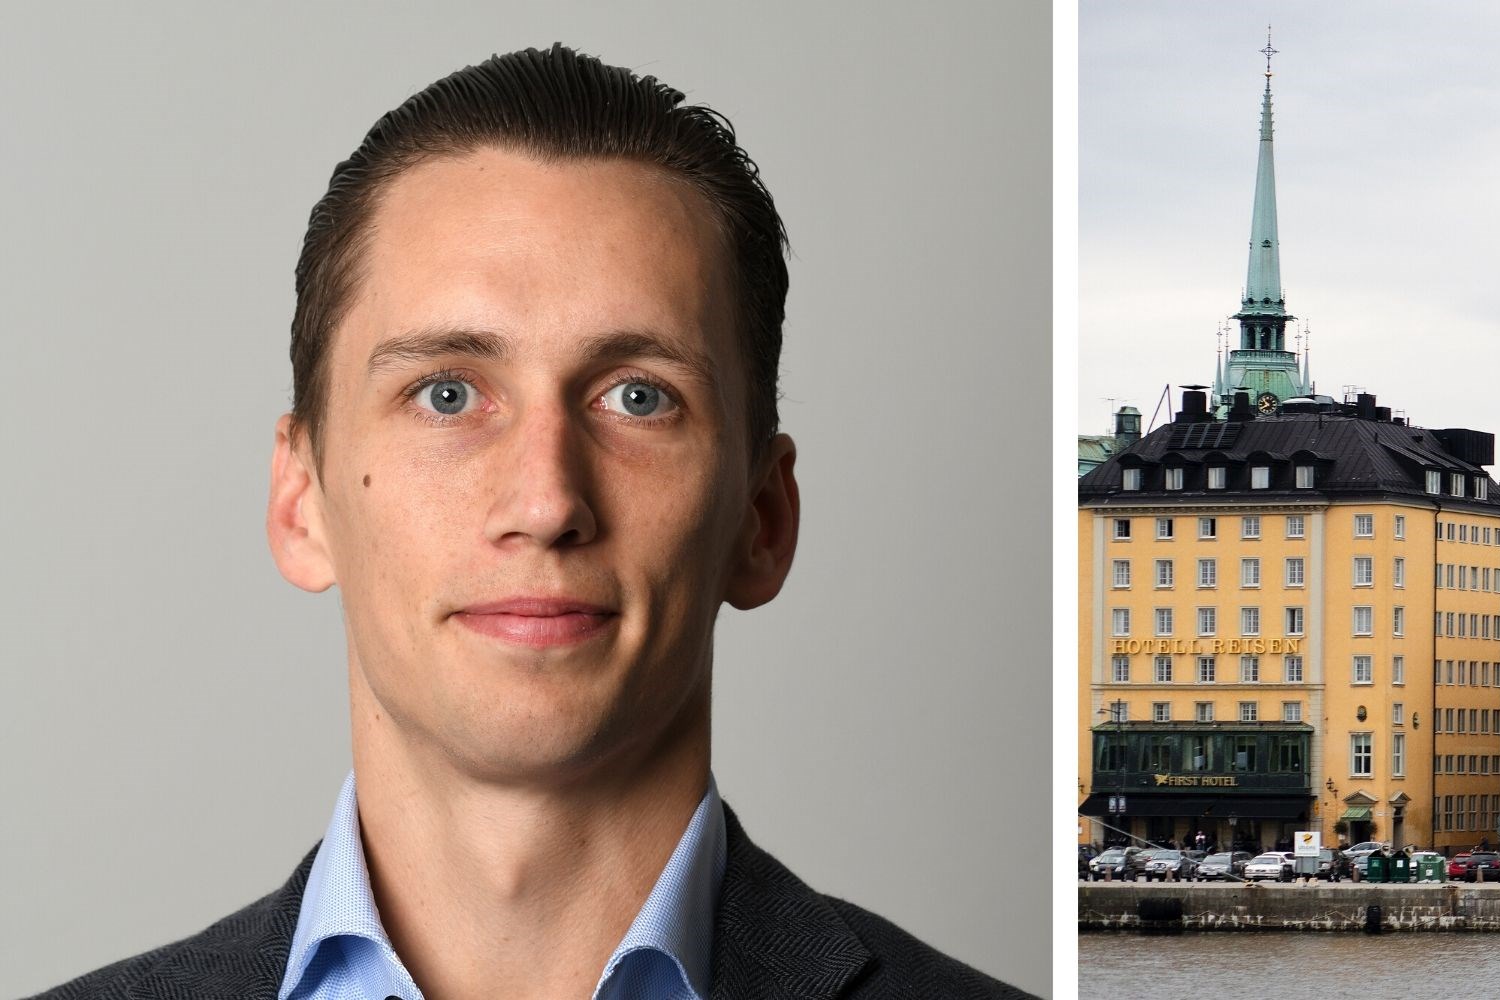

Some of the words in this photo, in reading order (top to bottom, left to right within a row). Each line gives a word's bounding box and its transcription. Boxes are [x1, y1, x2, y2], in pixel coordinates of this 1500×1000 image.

[1112, 638, 1203, 655] HOTELL
[1211, 638, 1302, 655] REISEN
[1168, 776, 1200, 786] FIRST
[1201, 776, 1239, 786] HOTEL
